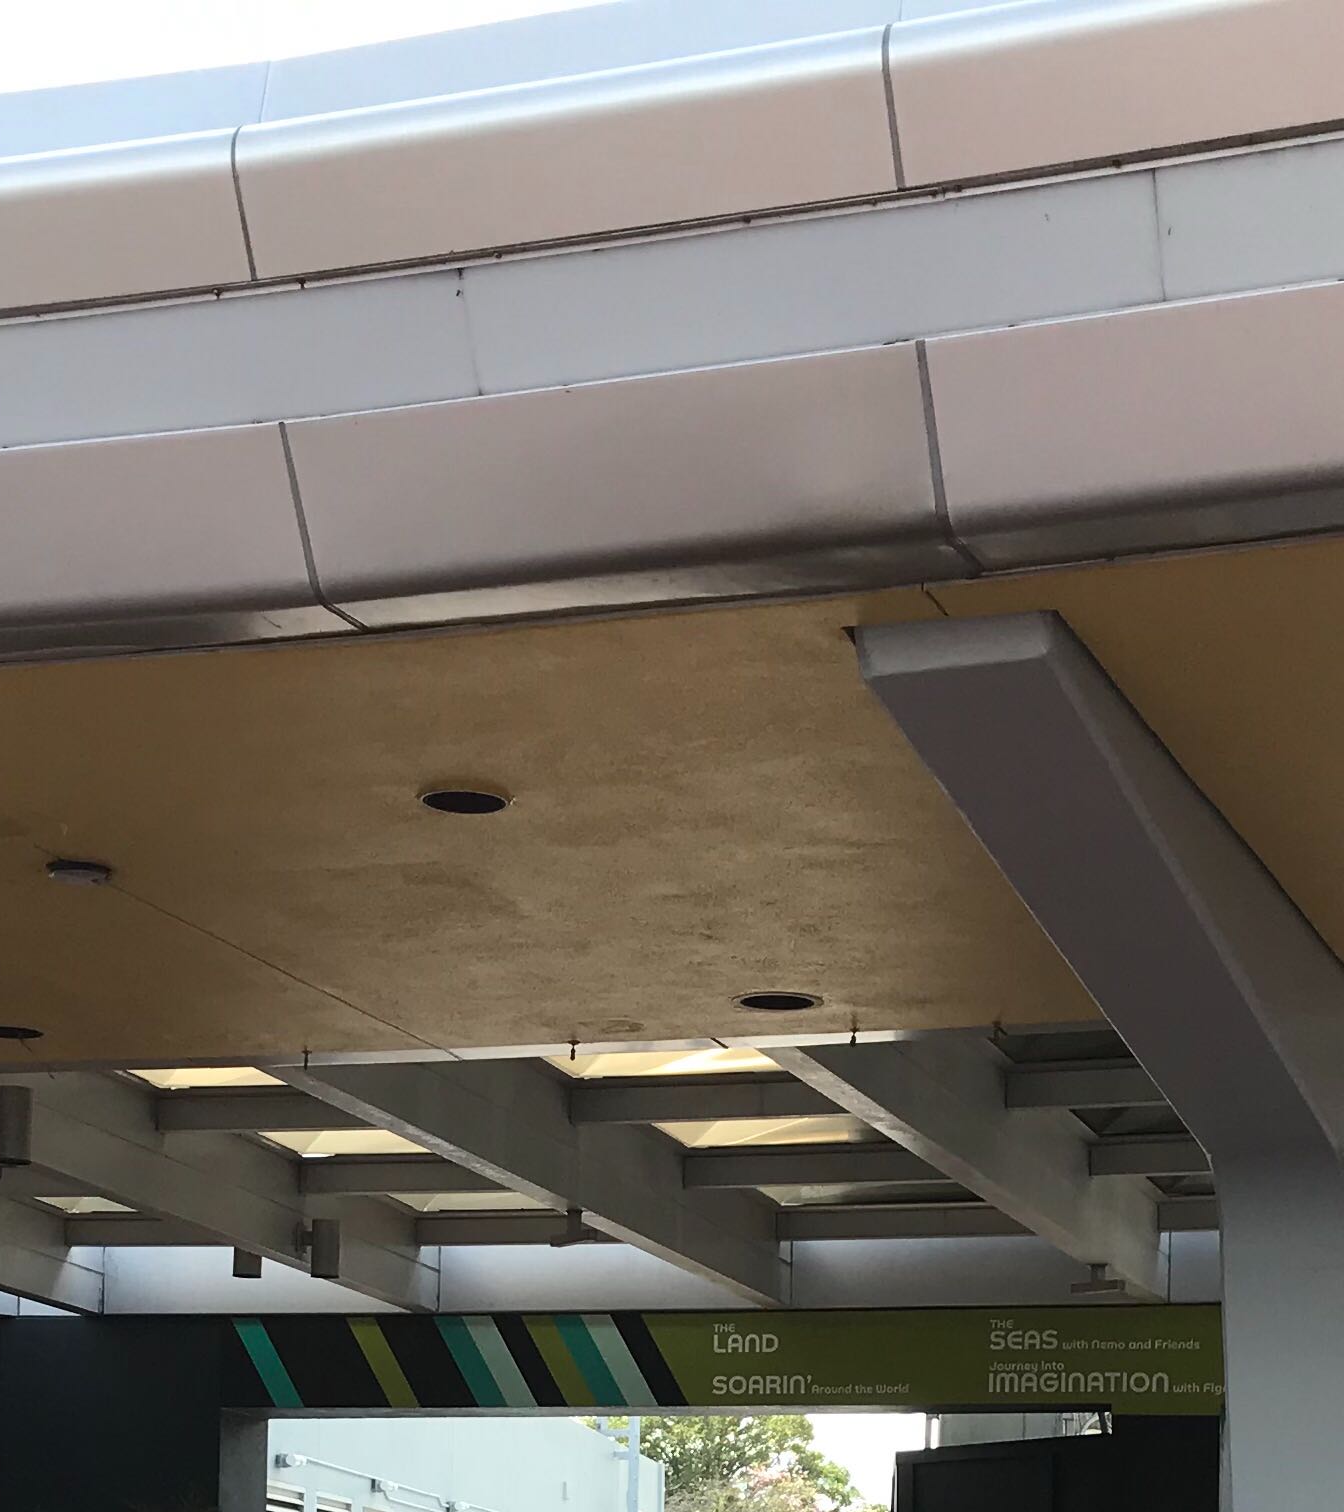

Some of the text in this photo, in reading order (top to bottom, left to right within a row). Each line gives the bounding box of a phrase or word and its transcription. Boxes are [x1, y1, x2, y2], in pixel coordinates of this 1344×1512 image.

[713, 1323, 735, 1333] THE
[990, 1319, 1013, 1329] THE
[713, 1333, 779, 1353] LAND
[990, 1330, 1058, 1350] SEAS
[1062, 1340, 1088, 1350] with
[1128, 1339, 1152, 1350] and
[1154, 1339, 1200, 1350] Friends
[989, 1361, 1065, 1372] Journey Into
[712, 1374, 910, 1394] SOARIN' Around the World
[988, 1372, 1225, 1395] IMAGINATION with Fig
